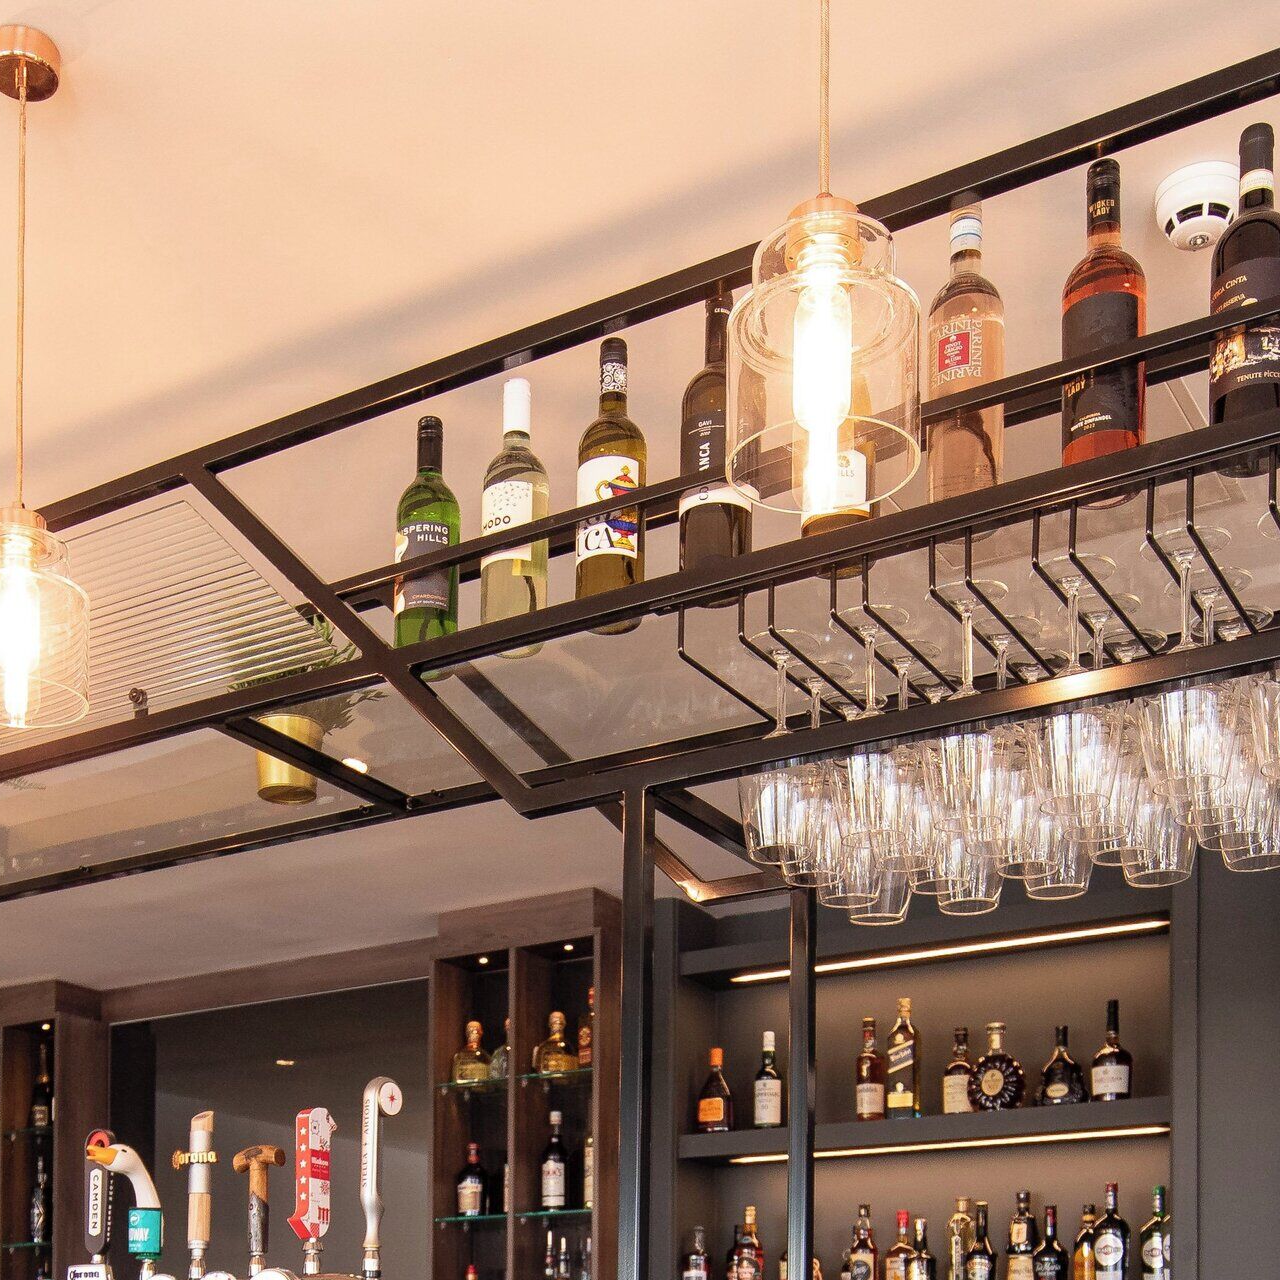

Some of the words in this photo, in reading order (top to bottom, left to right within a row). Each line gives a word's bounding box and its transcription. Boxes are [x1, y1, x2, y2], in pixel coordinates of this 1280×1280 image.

[1092, 206, 1111, 218] LADY
[1225, 275, 1248, 289] CINTA
[935, 319, 972, 339] ARINI
[971, 319, 983, 367] PARINI
[1237, 371, 1262, 383] TENUTE
[1067, 379, 1086, 398] LADY
[403, 523, 449, 536] SPERING
[483, 515, 511, 530] MODO
[417, 534, 449, 545] HILLS
[363, 1098, 371, 1135] ARTOIS
[172, 1150, 217, 1170] Corona
[92, 1174, 100, 1230] CAMDEN
